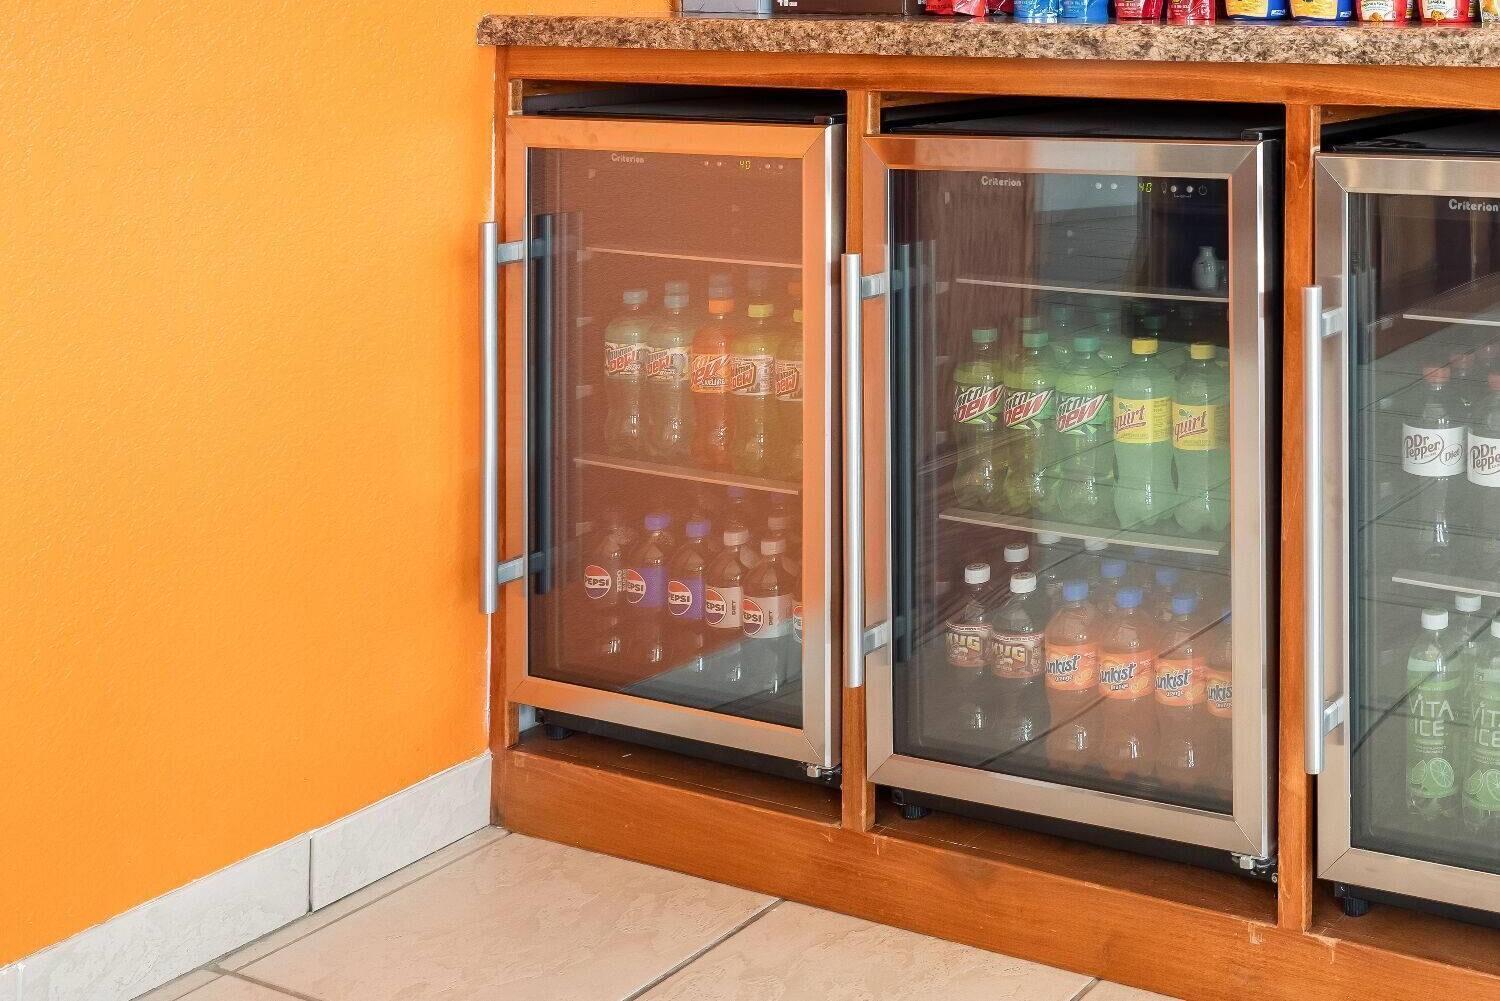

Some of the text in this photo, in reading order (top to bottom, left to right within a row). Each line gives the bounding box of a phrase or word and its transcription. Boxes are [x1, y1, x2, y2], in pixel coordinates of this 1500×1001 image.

[611, 152, 645, 164] Criterion
[981, 175, 1022, 188] Criterion
[1448, 198, 1499, 213] Criterion
[1414, 434, 1430, 447] Dr
[1404, 436, 1461, 462] Pepper Diet
[1480, 443, 1497, 456] Dr
[584, 576, 610, 587] PEPSI
[1414, 718, 1445, 737] ICE
